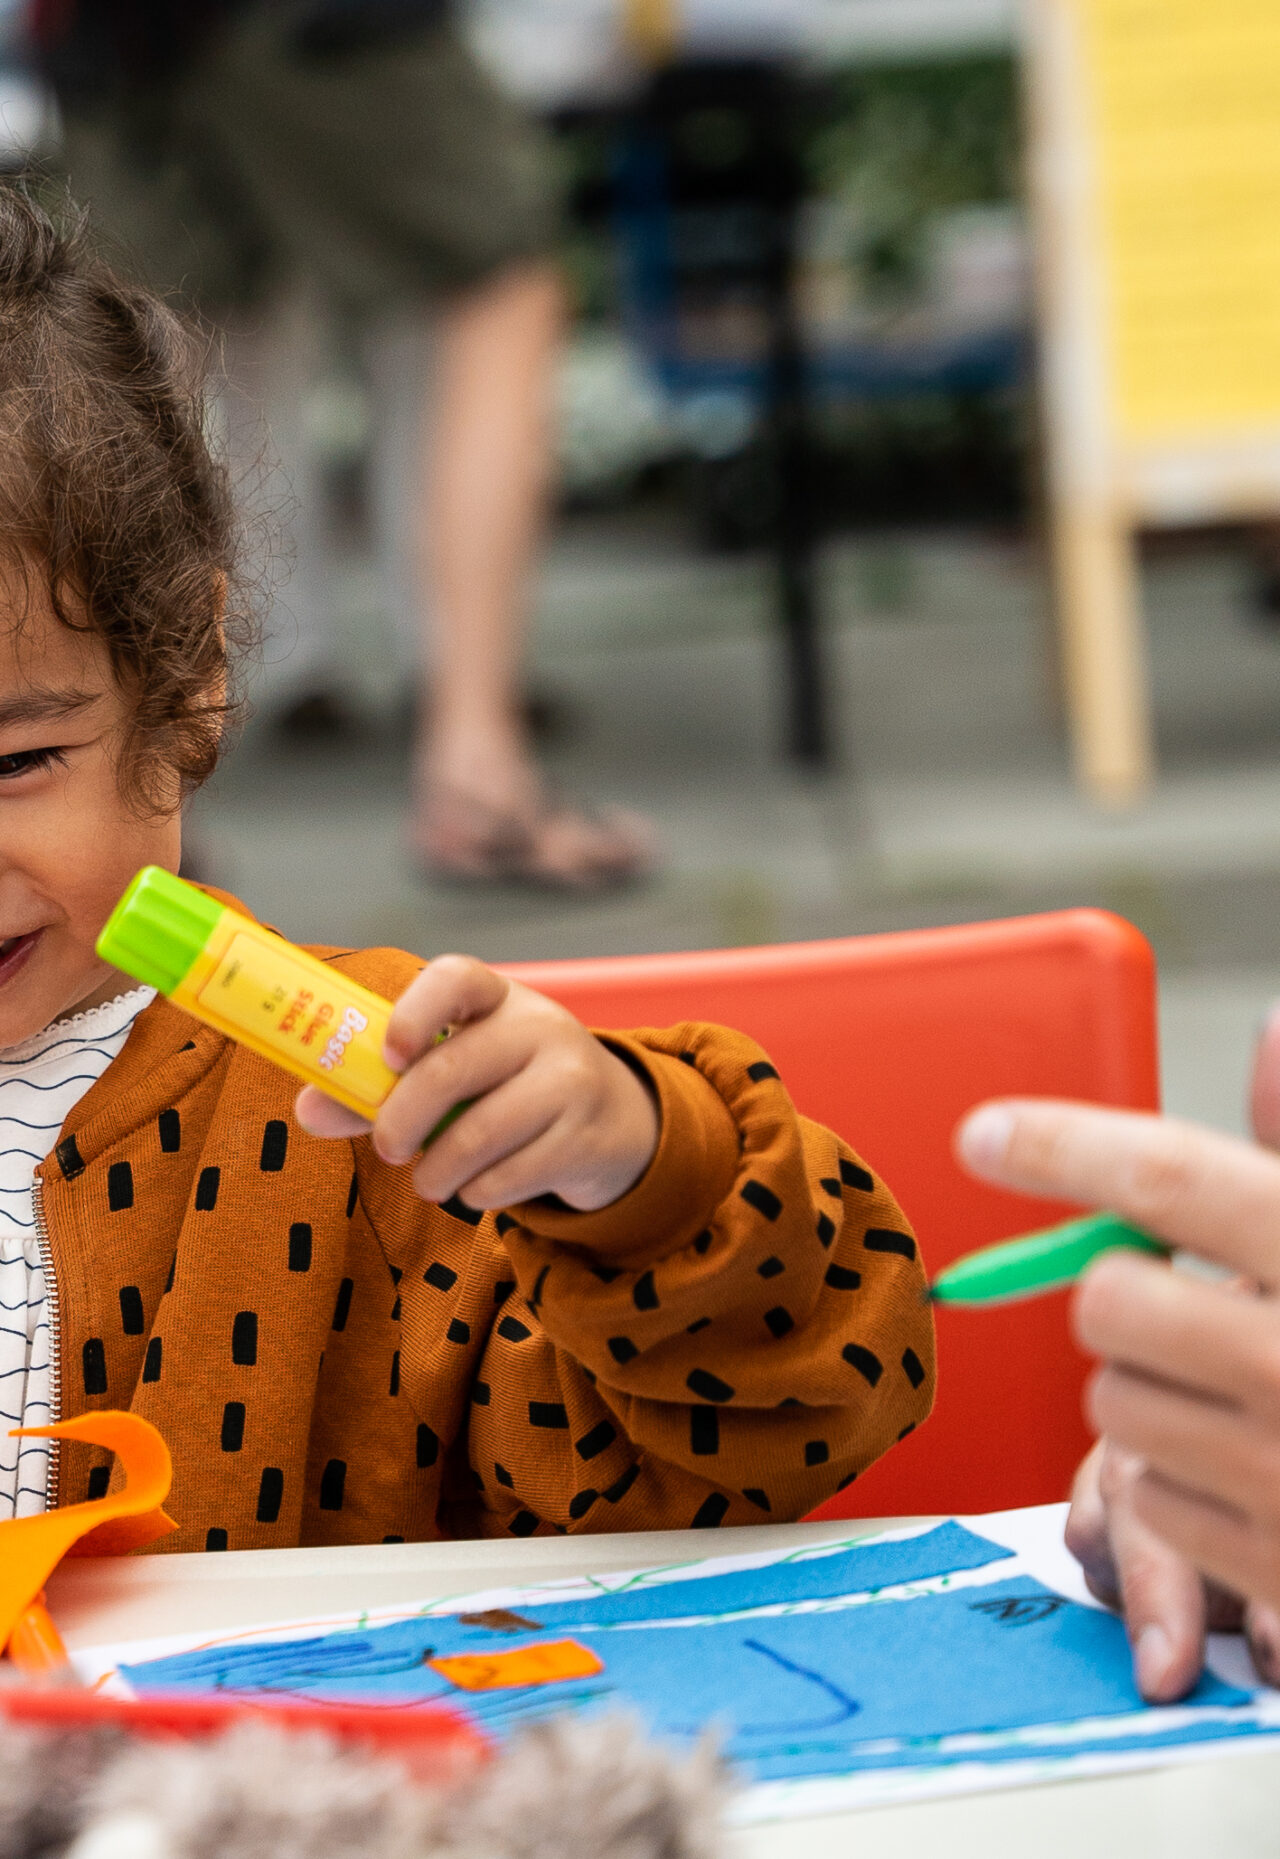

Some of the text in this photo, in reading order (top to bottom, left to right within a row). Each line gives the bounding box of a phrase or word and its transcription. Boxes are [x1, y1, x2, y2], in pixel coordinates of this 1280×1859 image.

[279, 989, 314, 1033] Stick
[301, 1003, 334, 1046] Glue
[318, 1006, 368, 1071] Basic
